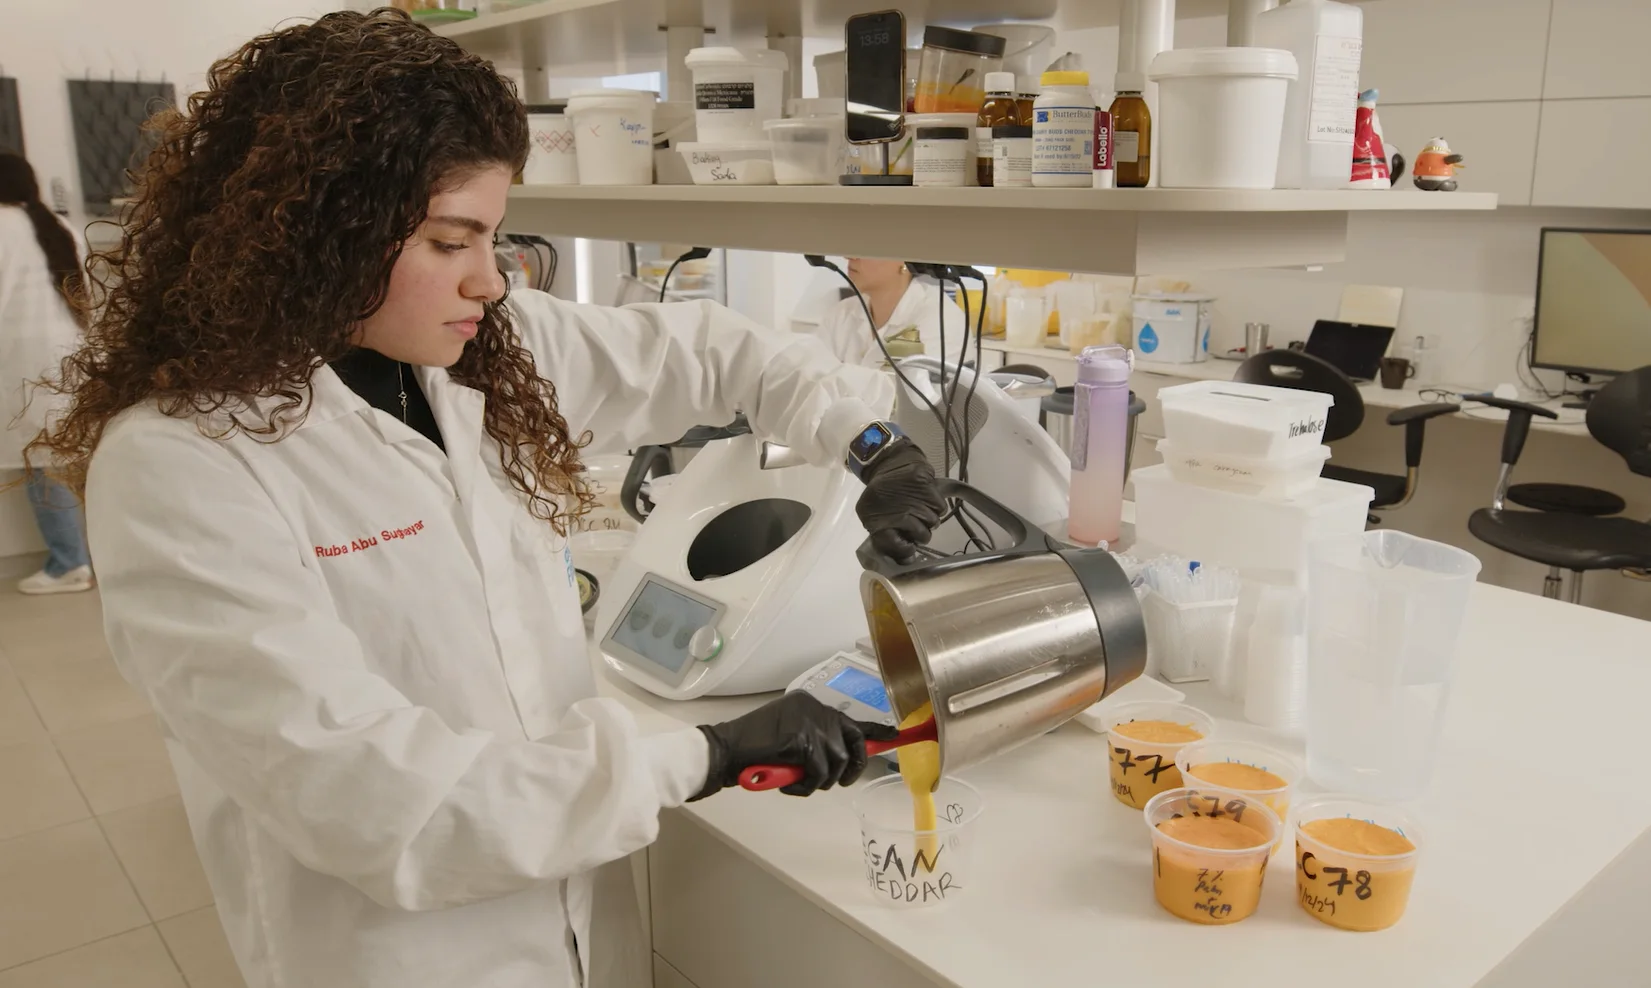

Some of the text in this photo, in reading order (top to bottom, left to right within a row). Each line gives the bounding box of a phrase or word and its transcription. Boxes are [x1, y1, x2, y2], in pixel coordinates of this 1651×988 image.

[1097, 126, 1108, 167] Labello
[314, 545, 348, 557] Ruba
[350, 536, 378, 552] Abu
